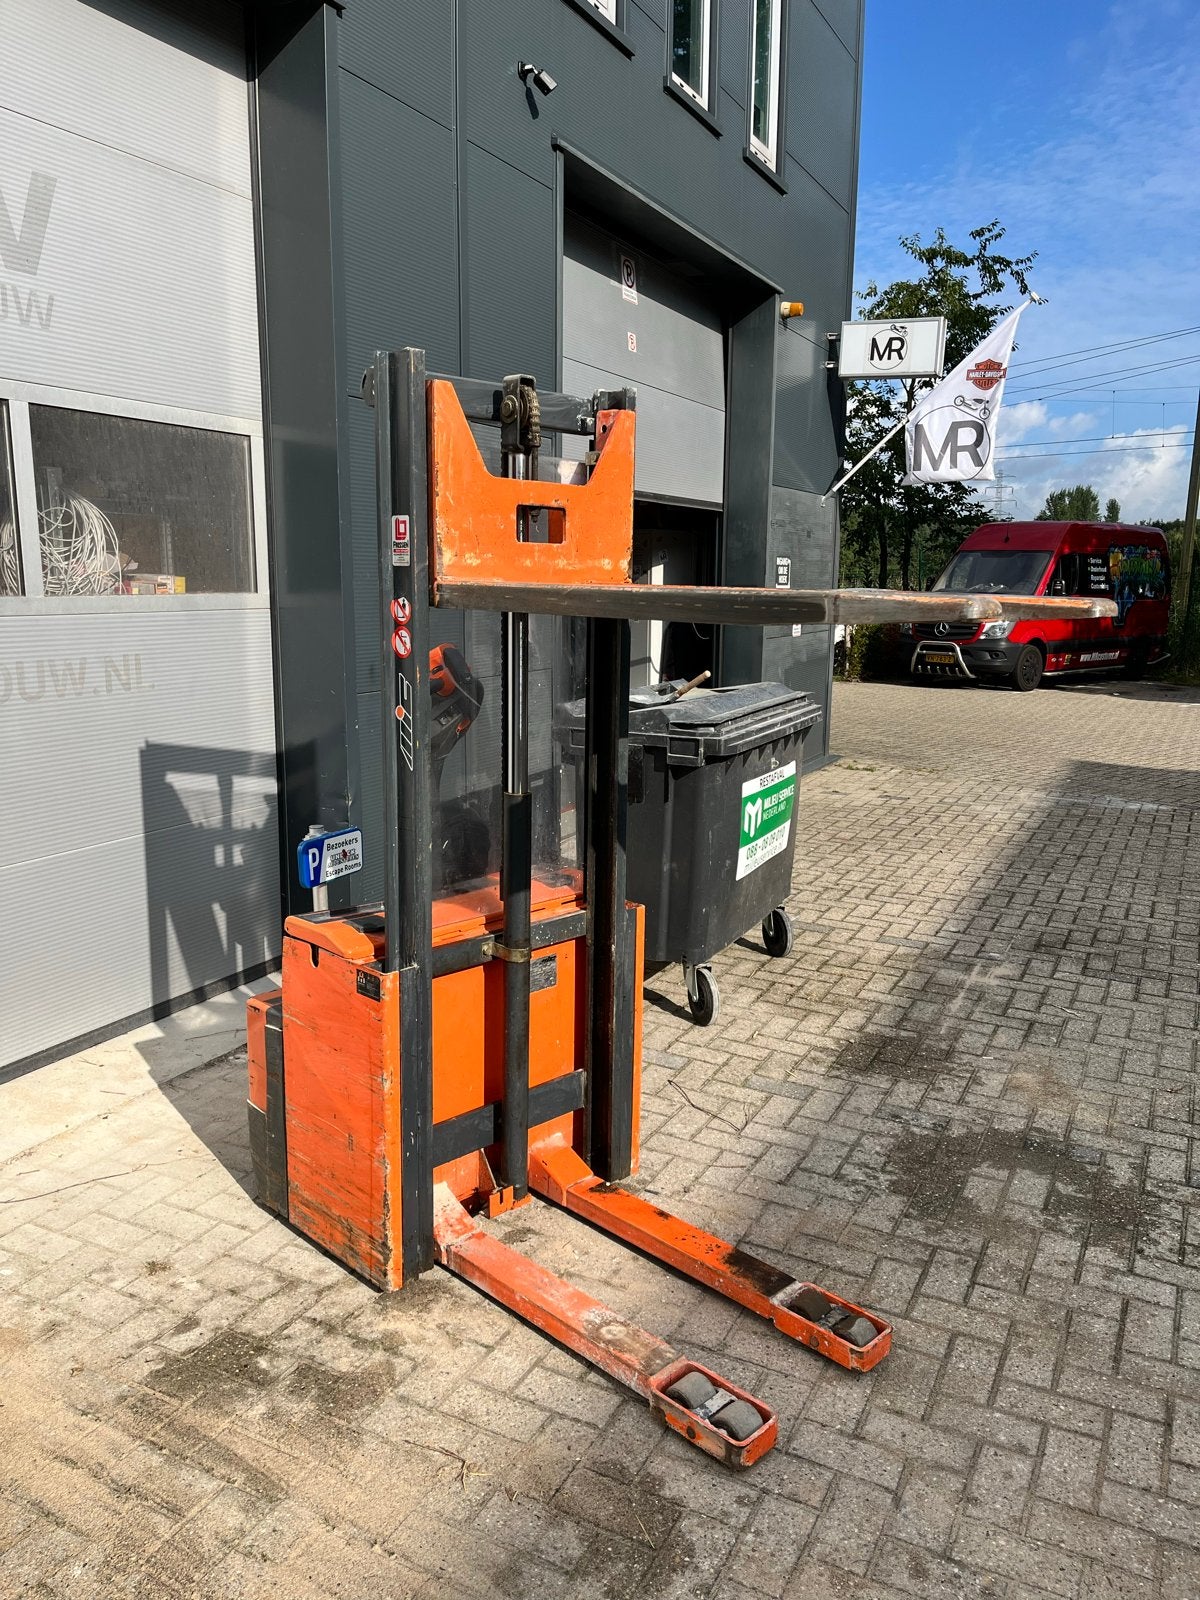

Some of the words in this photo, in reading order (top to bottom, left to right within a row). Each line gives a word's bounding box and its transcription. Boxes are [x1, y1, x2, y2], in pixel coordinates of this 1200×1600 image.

[870, 336, 905, 361] MR
[912, 420, 985, 472] MR
[760, 769, 785, 788] RESTAFVAL
[778, 784, 795, 801] SERVICE
[762, 801, 787, 821] NEDERLAND
[327, 837, 358, 851] Bezoekers
[325, 867, 344, 878] Escape
[344, 862, 361, 872] Rooms
